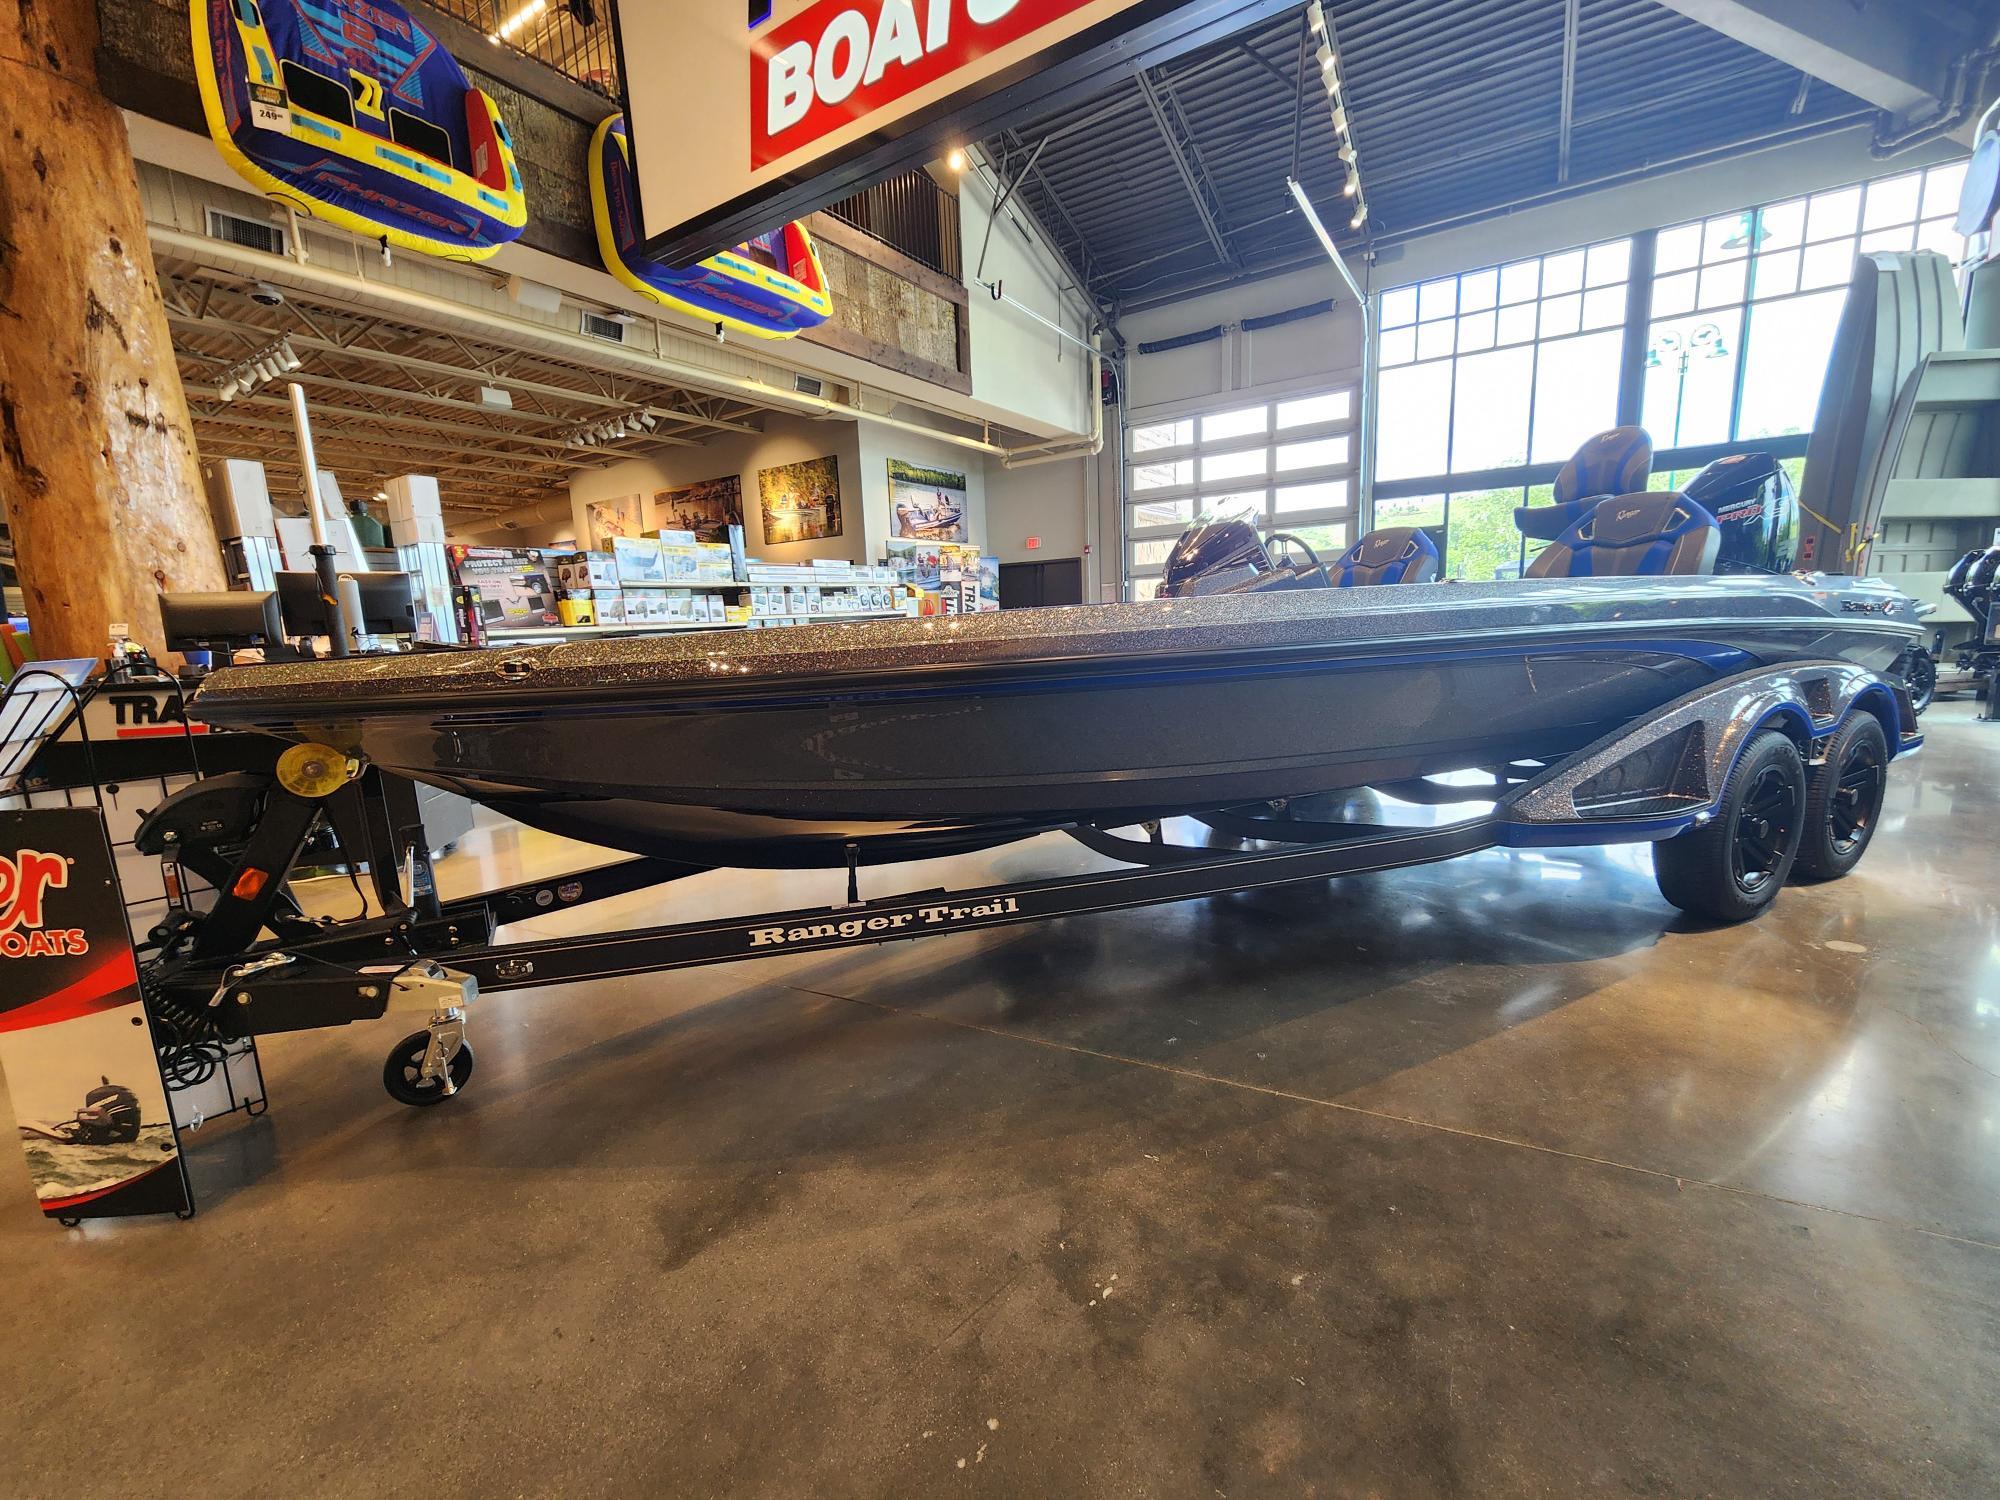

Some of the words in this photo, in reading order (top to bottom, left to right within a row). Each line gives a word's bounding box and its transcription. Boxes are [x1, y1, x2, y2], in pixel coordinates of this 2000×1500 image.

[767, 0, 1020, 136] BOAT
[1718, 498, 1757, 514] MERCURY
[109, 695, 200, 725] TRA
[748, 912, 913, 947] Ranger
[918, 897, 1020, 924] Trail
